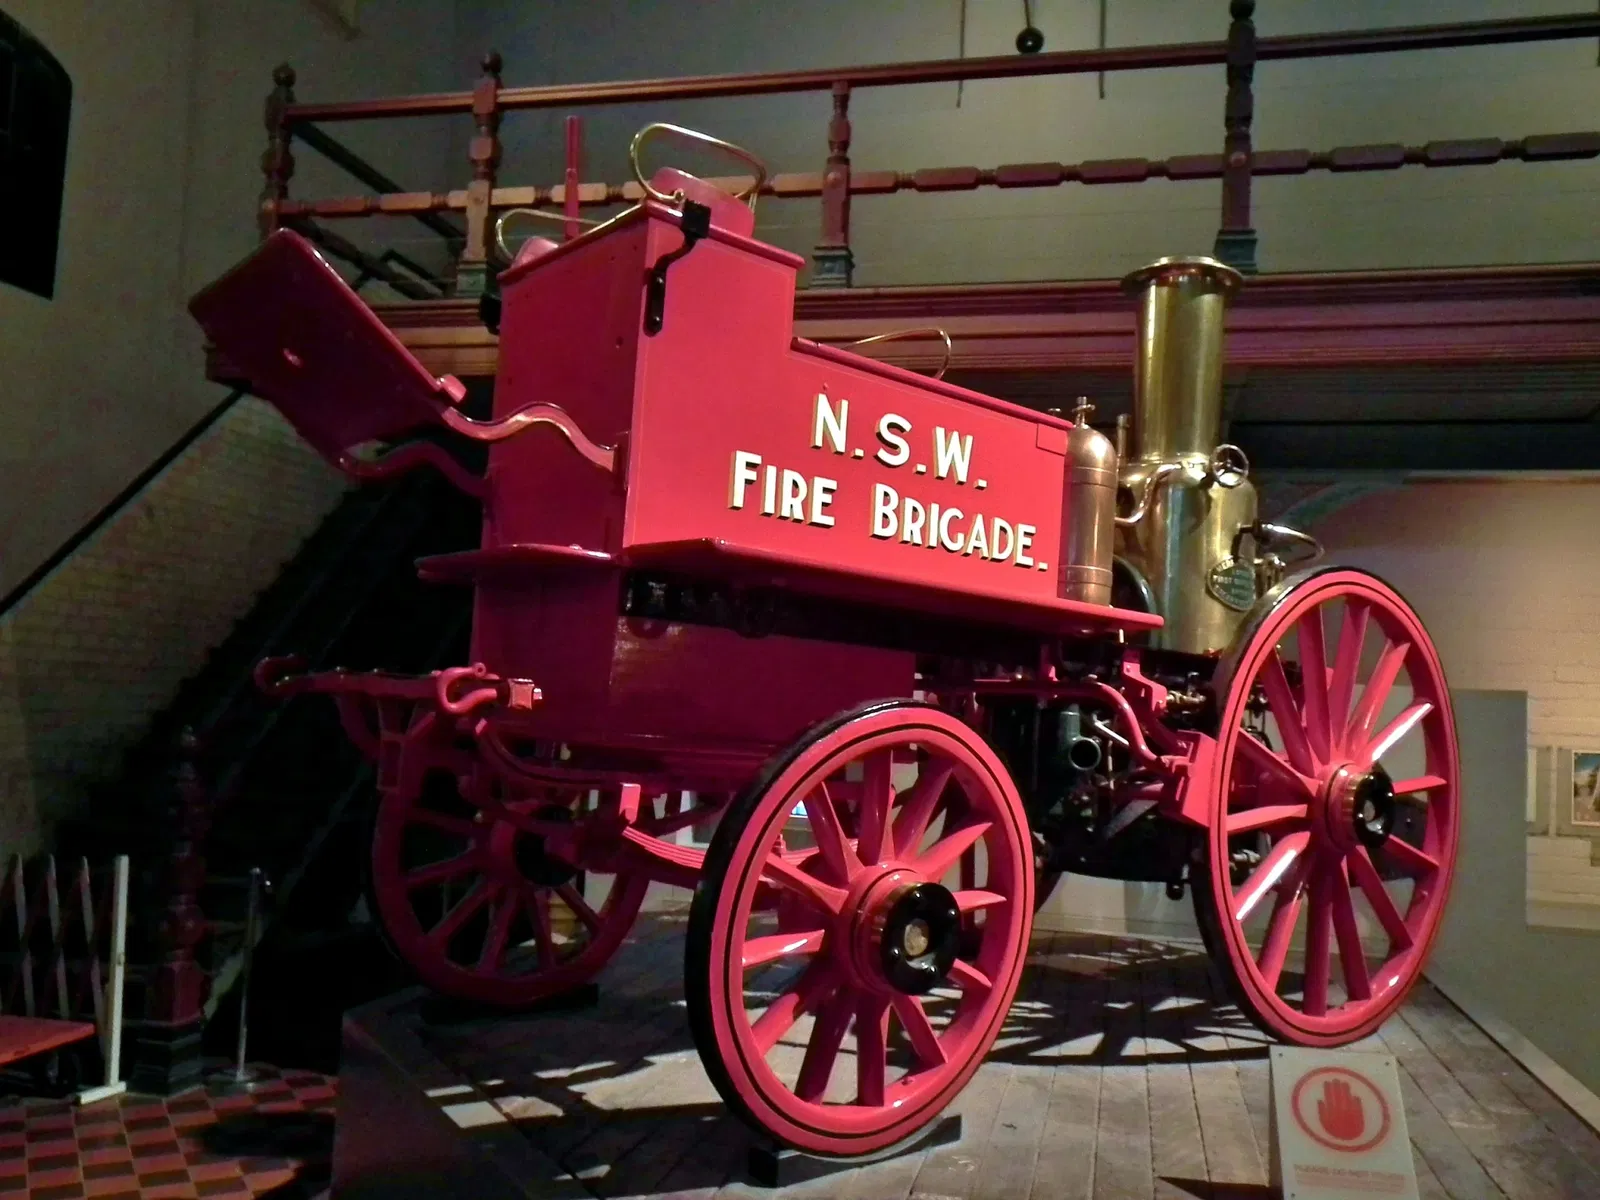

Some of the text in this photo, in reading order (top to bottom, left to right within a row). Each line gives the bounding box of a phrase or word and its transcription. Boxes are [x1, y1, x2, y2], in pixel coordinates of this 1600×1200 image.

[811, 393, 988, 489] N.S.W.
[728, 450, 1048, 571] FIRE BRIGADE.
